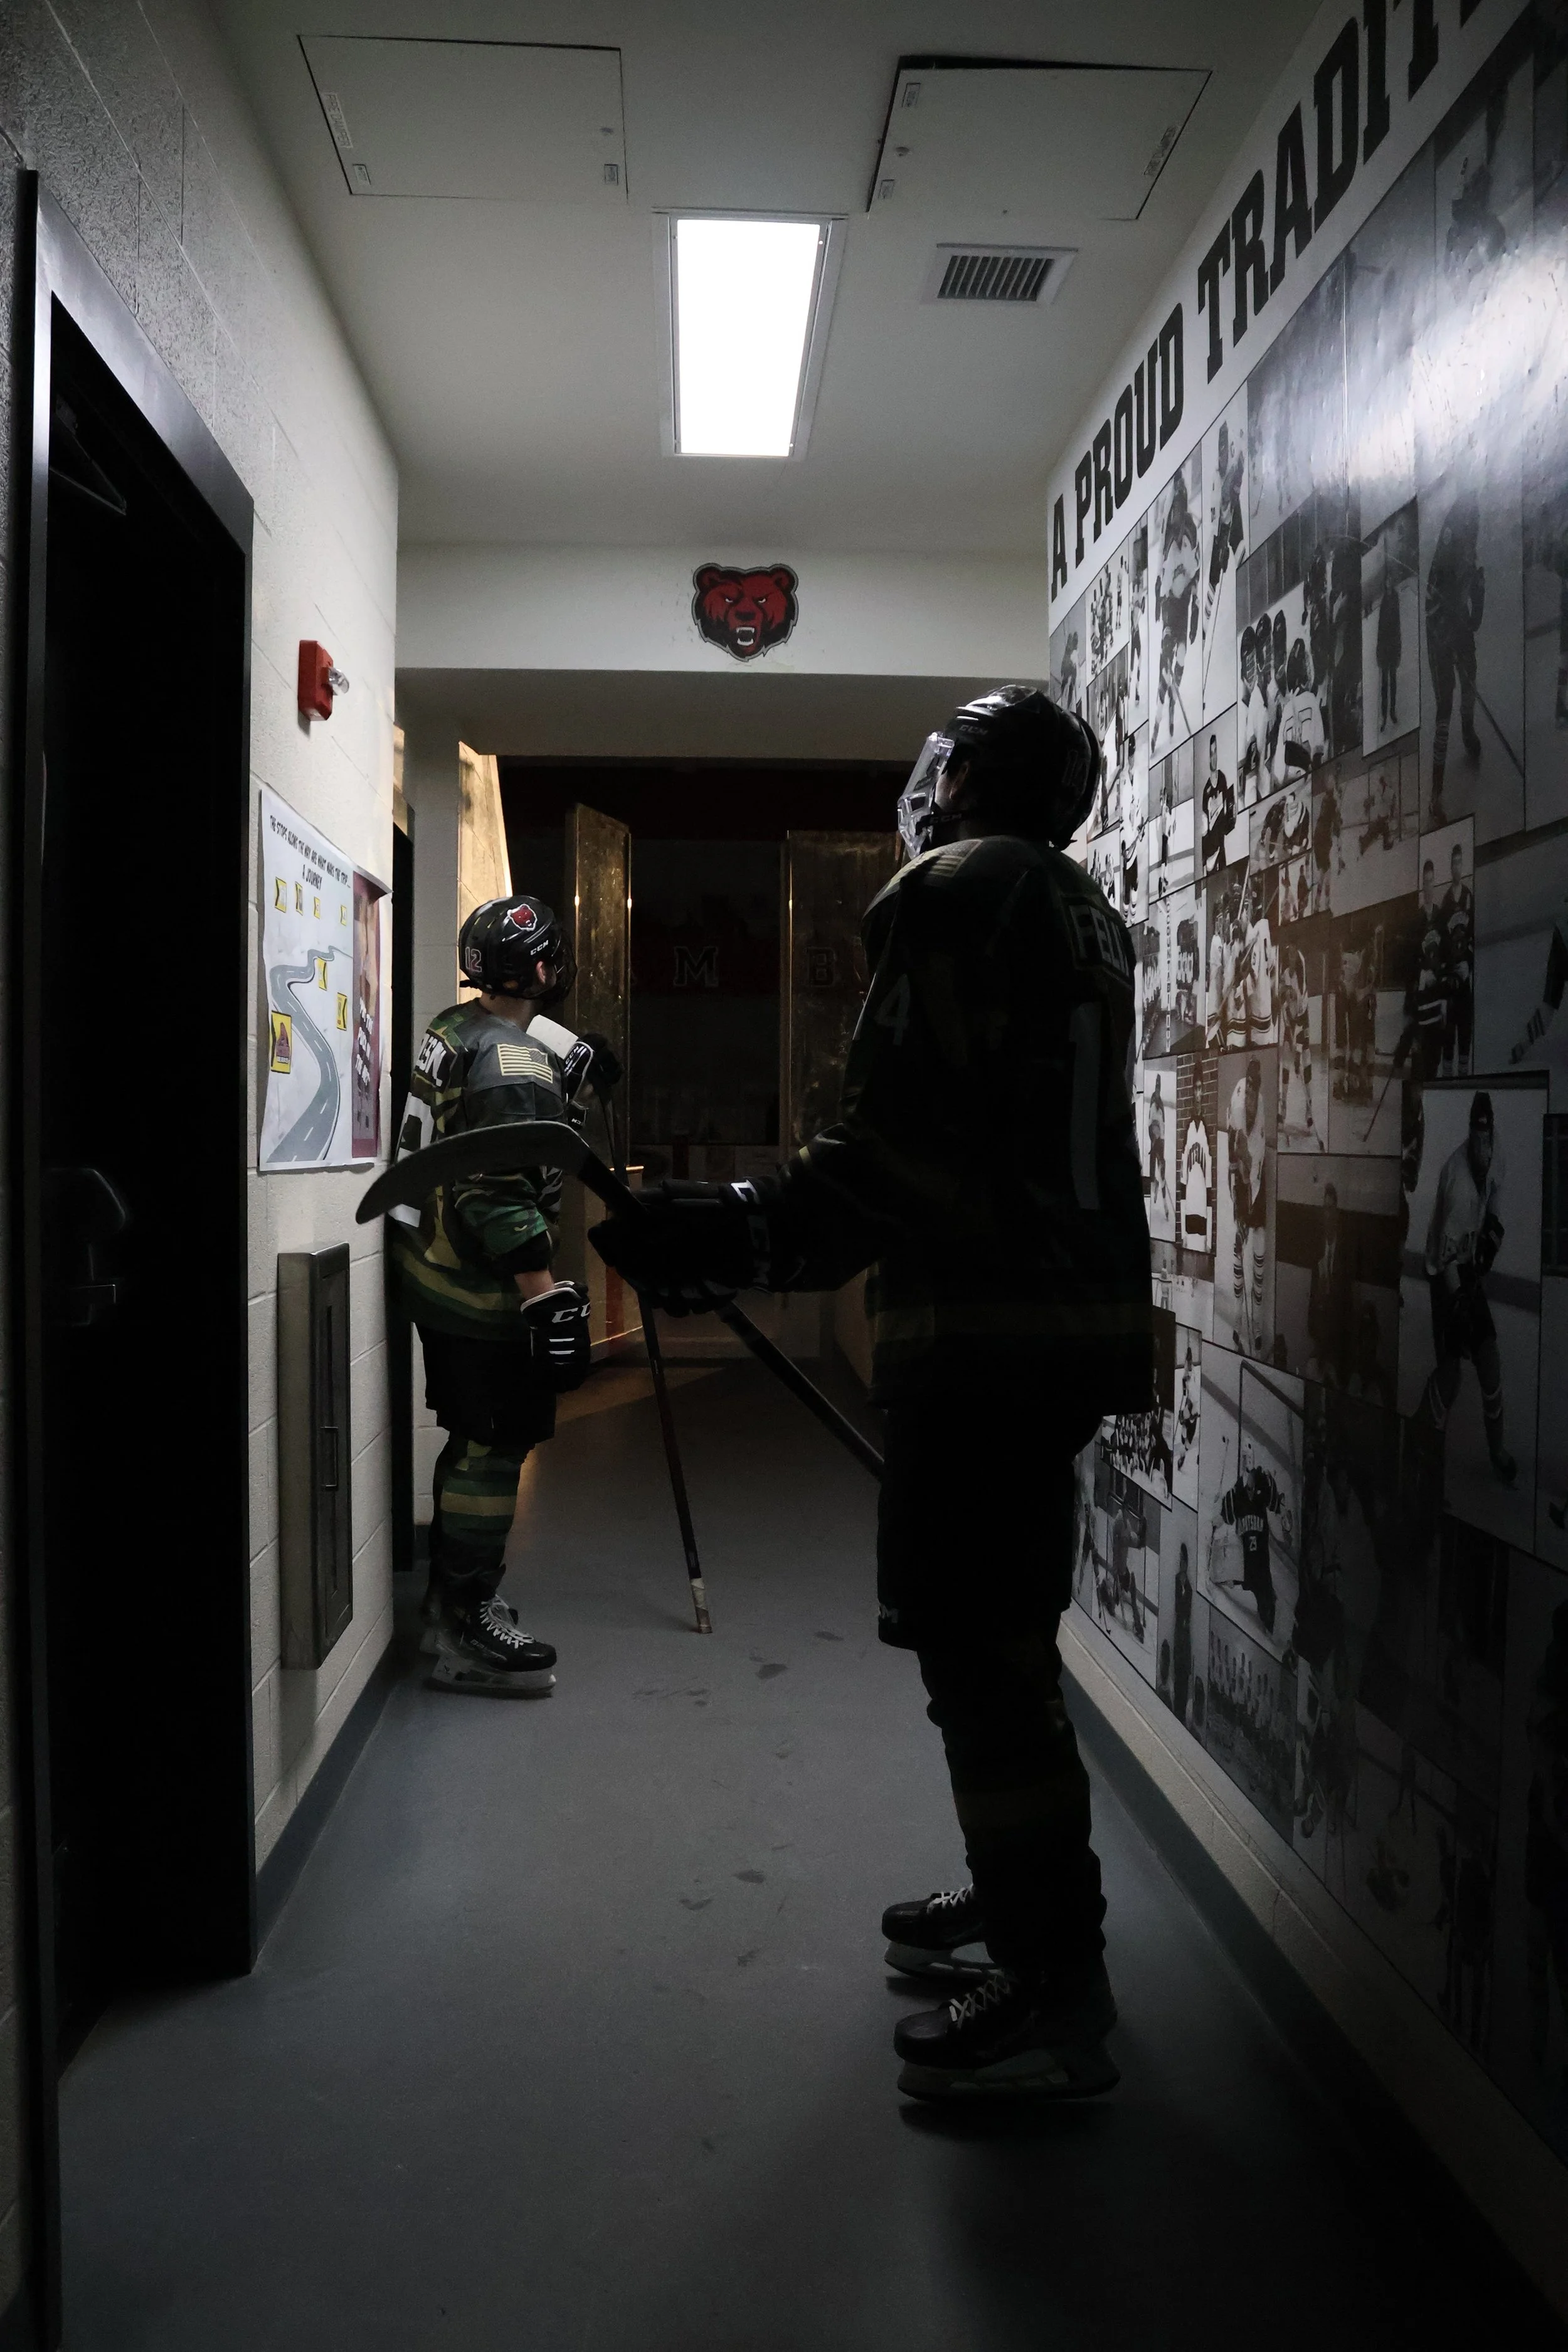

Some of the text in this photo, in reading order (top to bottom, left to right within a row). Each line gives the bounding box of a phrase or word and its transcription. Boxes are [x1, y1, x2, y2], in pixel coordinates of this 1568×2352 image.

[1051, 0, 1482, 603] A PROUD TRADIT
[465, 946, 483, 973] 12
[529, 940, 549, 956] CCM
